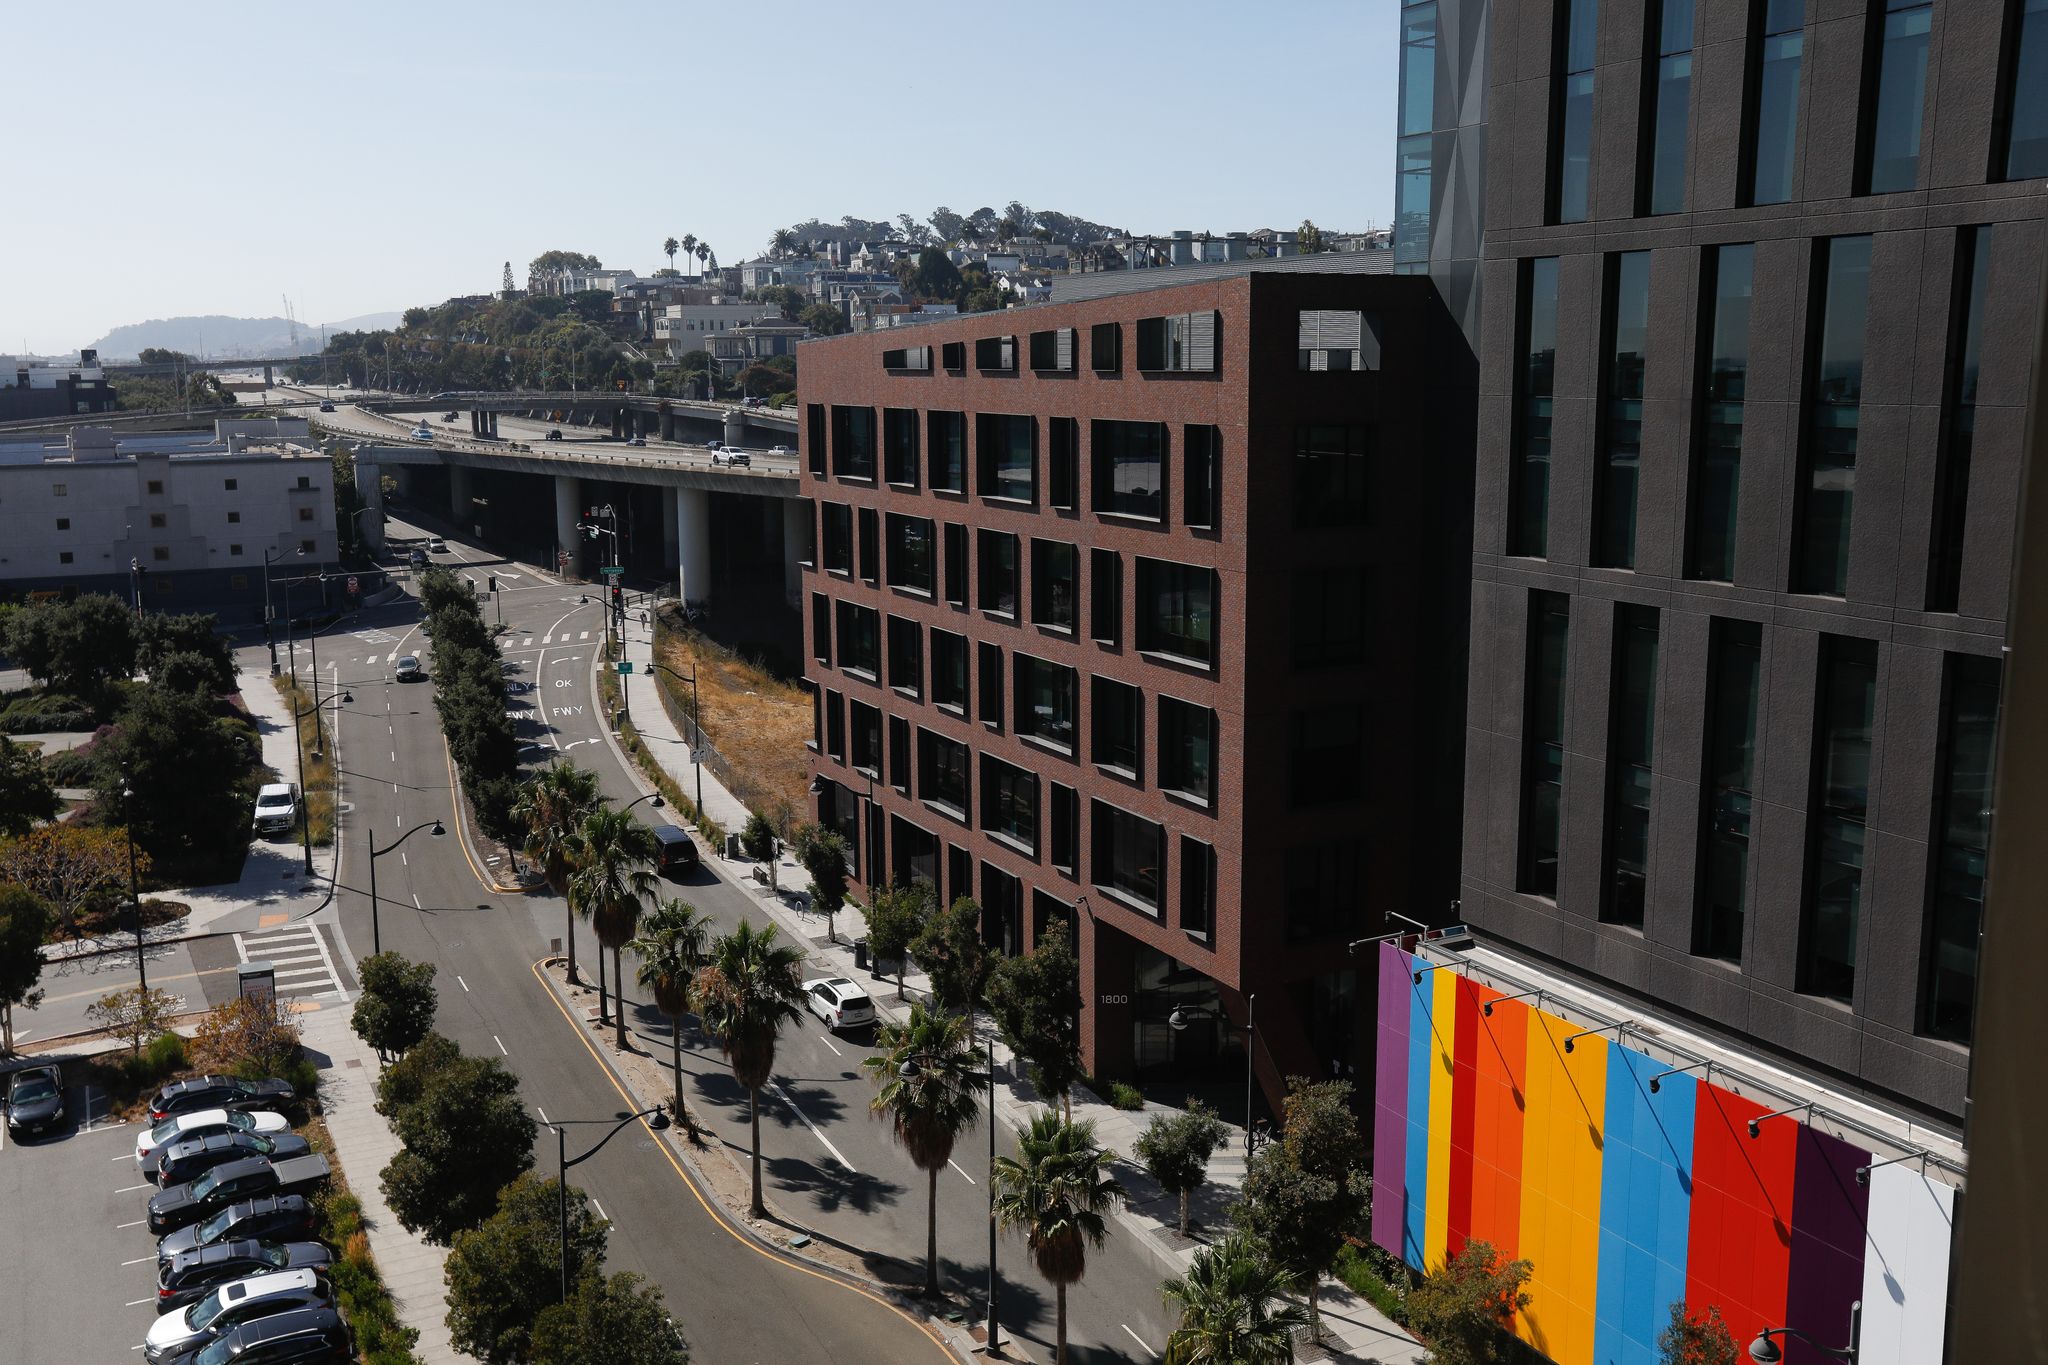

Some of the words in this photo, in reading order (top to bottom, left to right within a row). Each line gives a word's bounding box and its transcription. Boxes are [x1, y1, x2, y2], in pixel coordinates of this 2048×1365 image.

[504, 681, 531, 692] NLY
[555, 679, 573, 688] OK
[553, 705, 583, 717] FWY
[1100, 994, 1128, 1004] 1800
